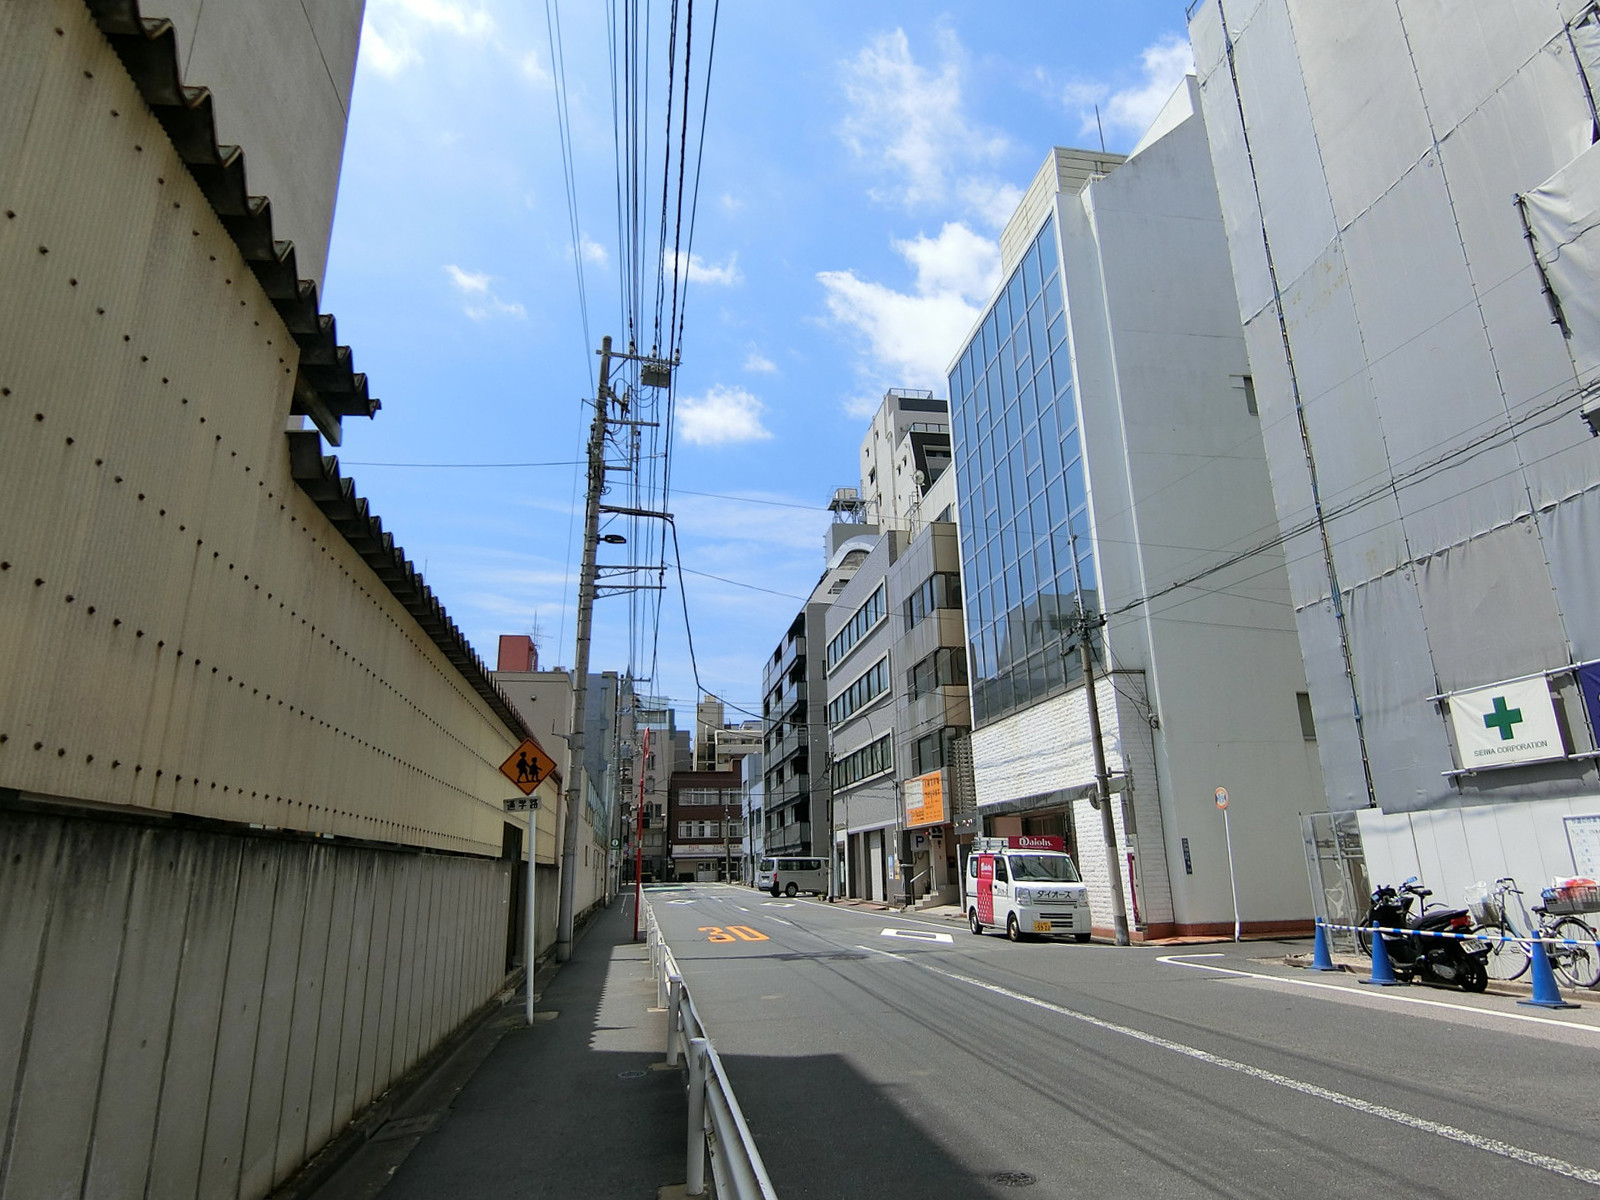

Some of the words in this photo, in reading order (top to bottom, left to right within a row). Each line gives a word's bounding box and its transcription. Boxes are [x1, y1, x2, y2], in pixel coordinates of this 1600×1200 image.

[1496, 740, 1548, 754] CORPORATION
[506, 799, 539, 811] 通学路
[915, 835, 925, 848] P
[1019, 836, 1052, 847] Daiohs
[697, 925, 771, 943] 30
